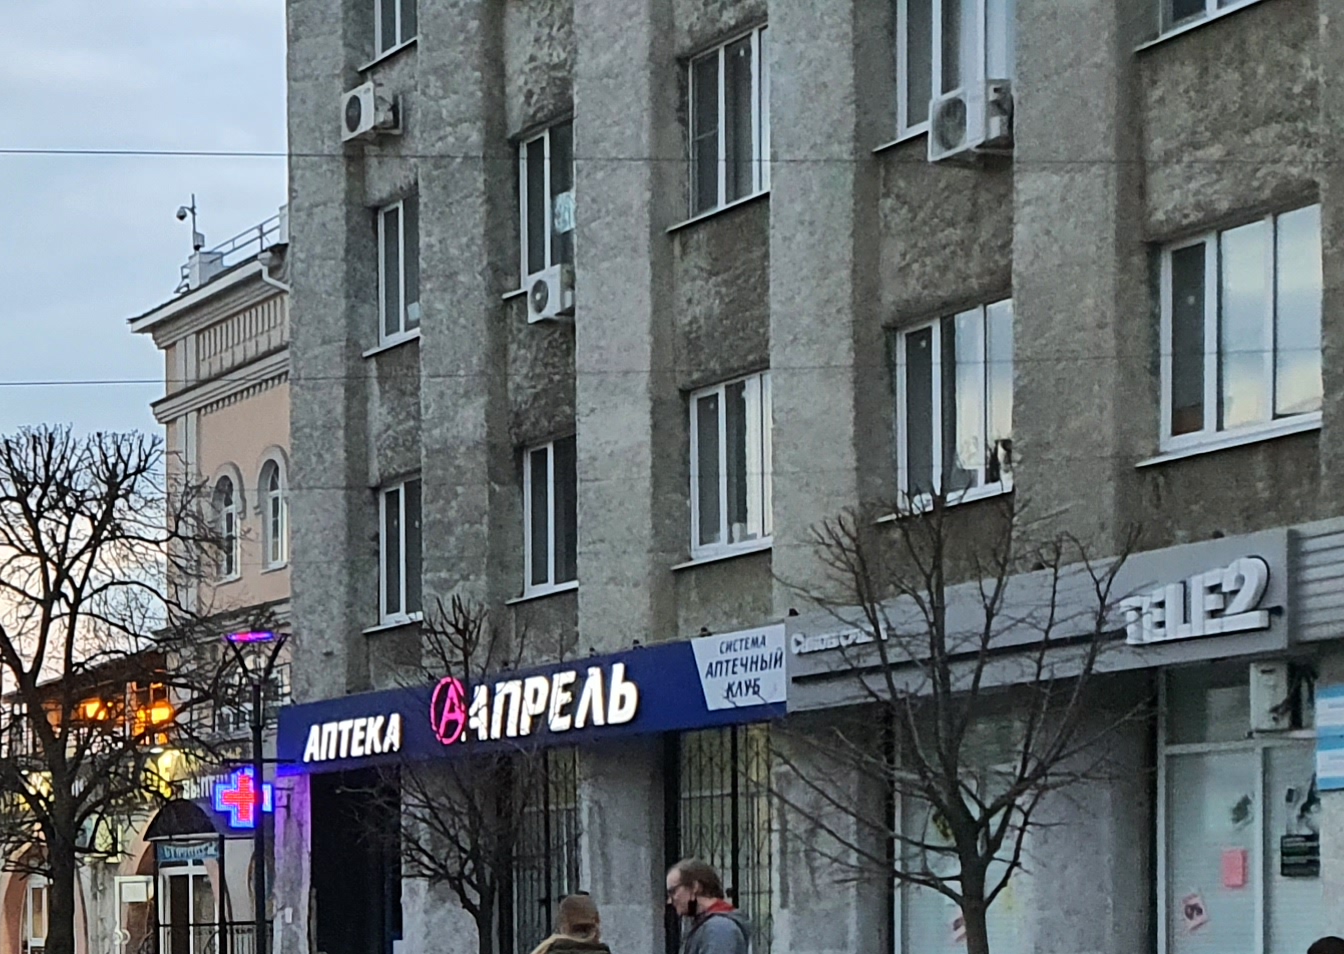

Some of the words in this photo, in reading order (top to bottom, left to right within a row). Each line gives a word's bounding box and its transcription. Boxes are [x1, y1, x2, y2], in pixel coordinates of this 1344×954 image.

[1120, 557, 1269, 645] TELE2
[720, 635, 766, 654] СИСТЕМА
[705, 647, 783, 679] АПТЕЧНЫЙ
[726, 678, 760, 698] КЛУБ
[303, 713, 400, 762] АПТЕКА
[461, 662, 638, 742] АПРЕЛЬ
